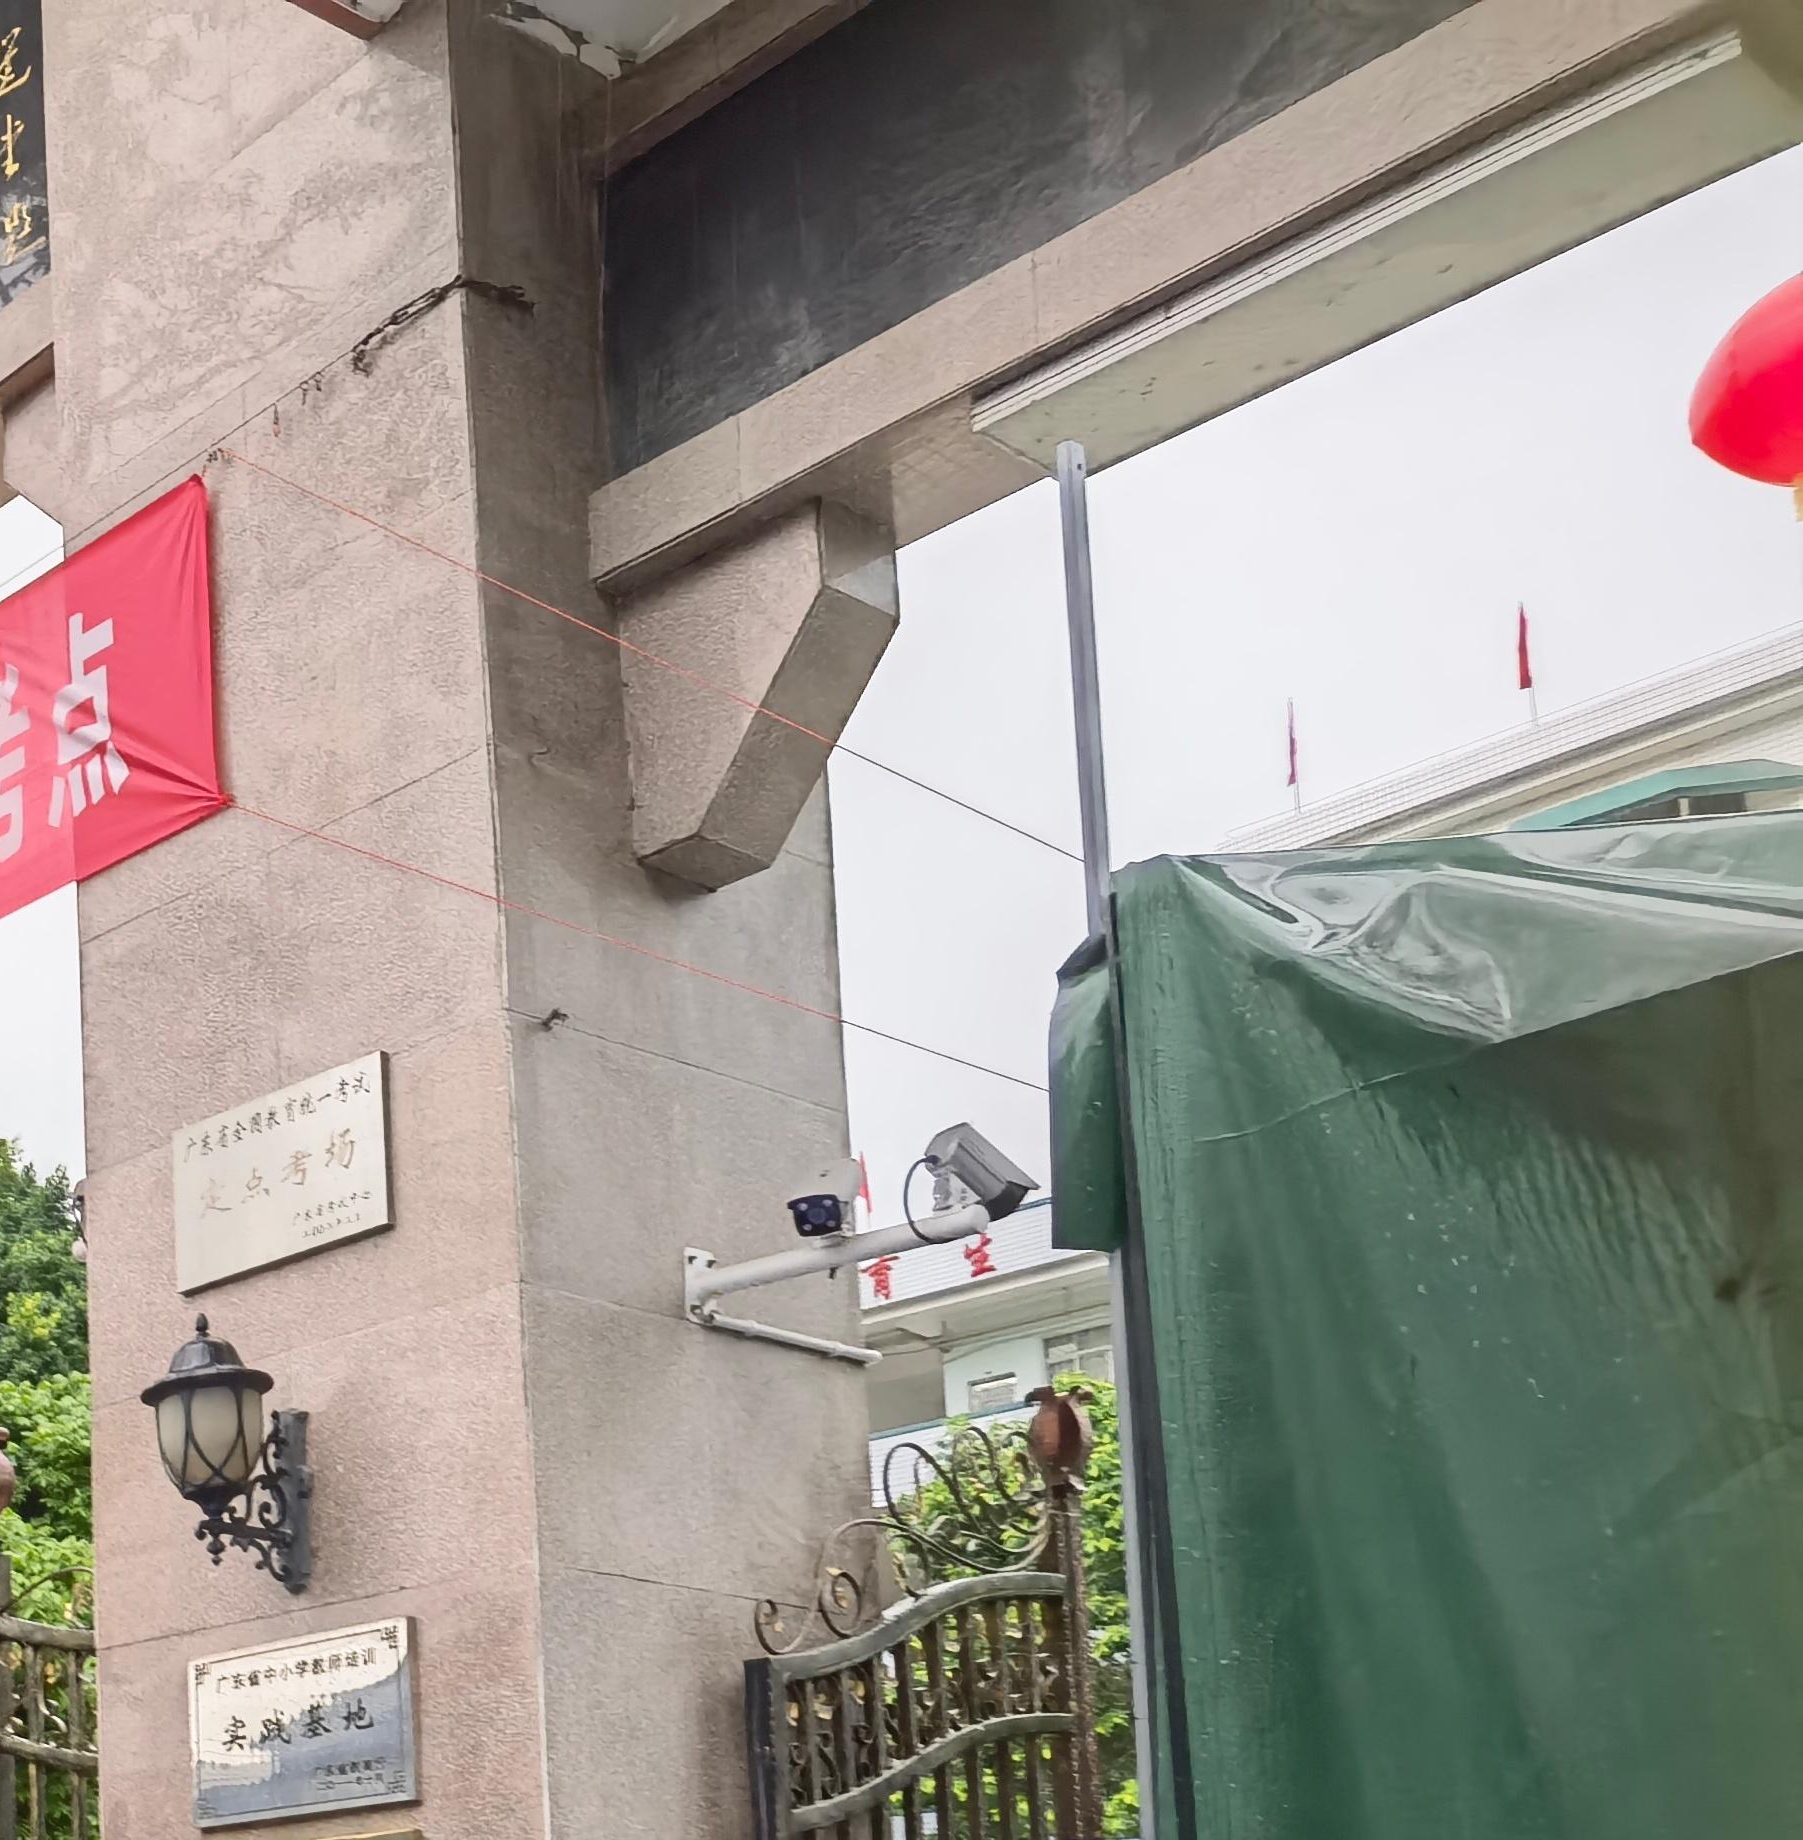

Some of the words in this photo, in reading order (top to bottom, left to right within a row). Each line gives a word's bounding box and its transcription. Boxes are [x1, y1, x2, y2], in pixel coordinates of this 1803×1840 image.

[199, 1127, 356, 1219] 定点考场
[222, 1698, 375, 1751] 实践基地
